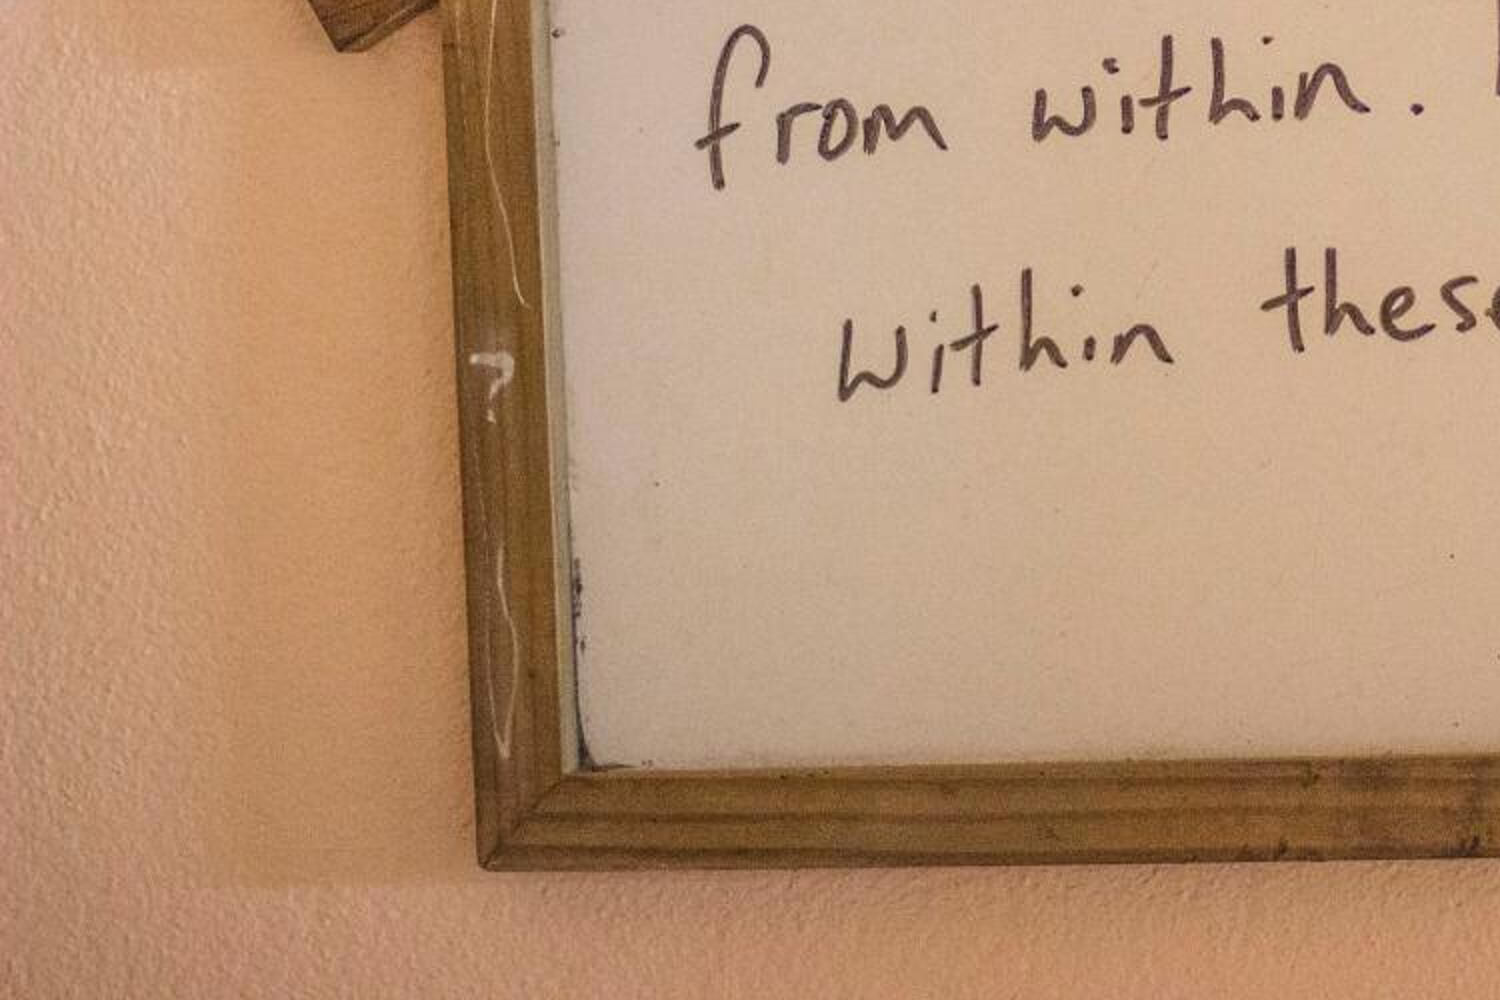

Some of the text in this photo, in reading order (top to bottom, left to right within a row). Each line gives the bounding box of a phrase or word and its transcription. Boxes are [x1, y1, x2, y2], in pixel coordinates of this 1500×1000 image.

[694, 23, 949, 191] from
[1031, 34, 1425, 144] within.
[838, 267, 1175, 403] within
